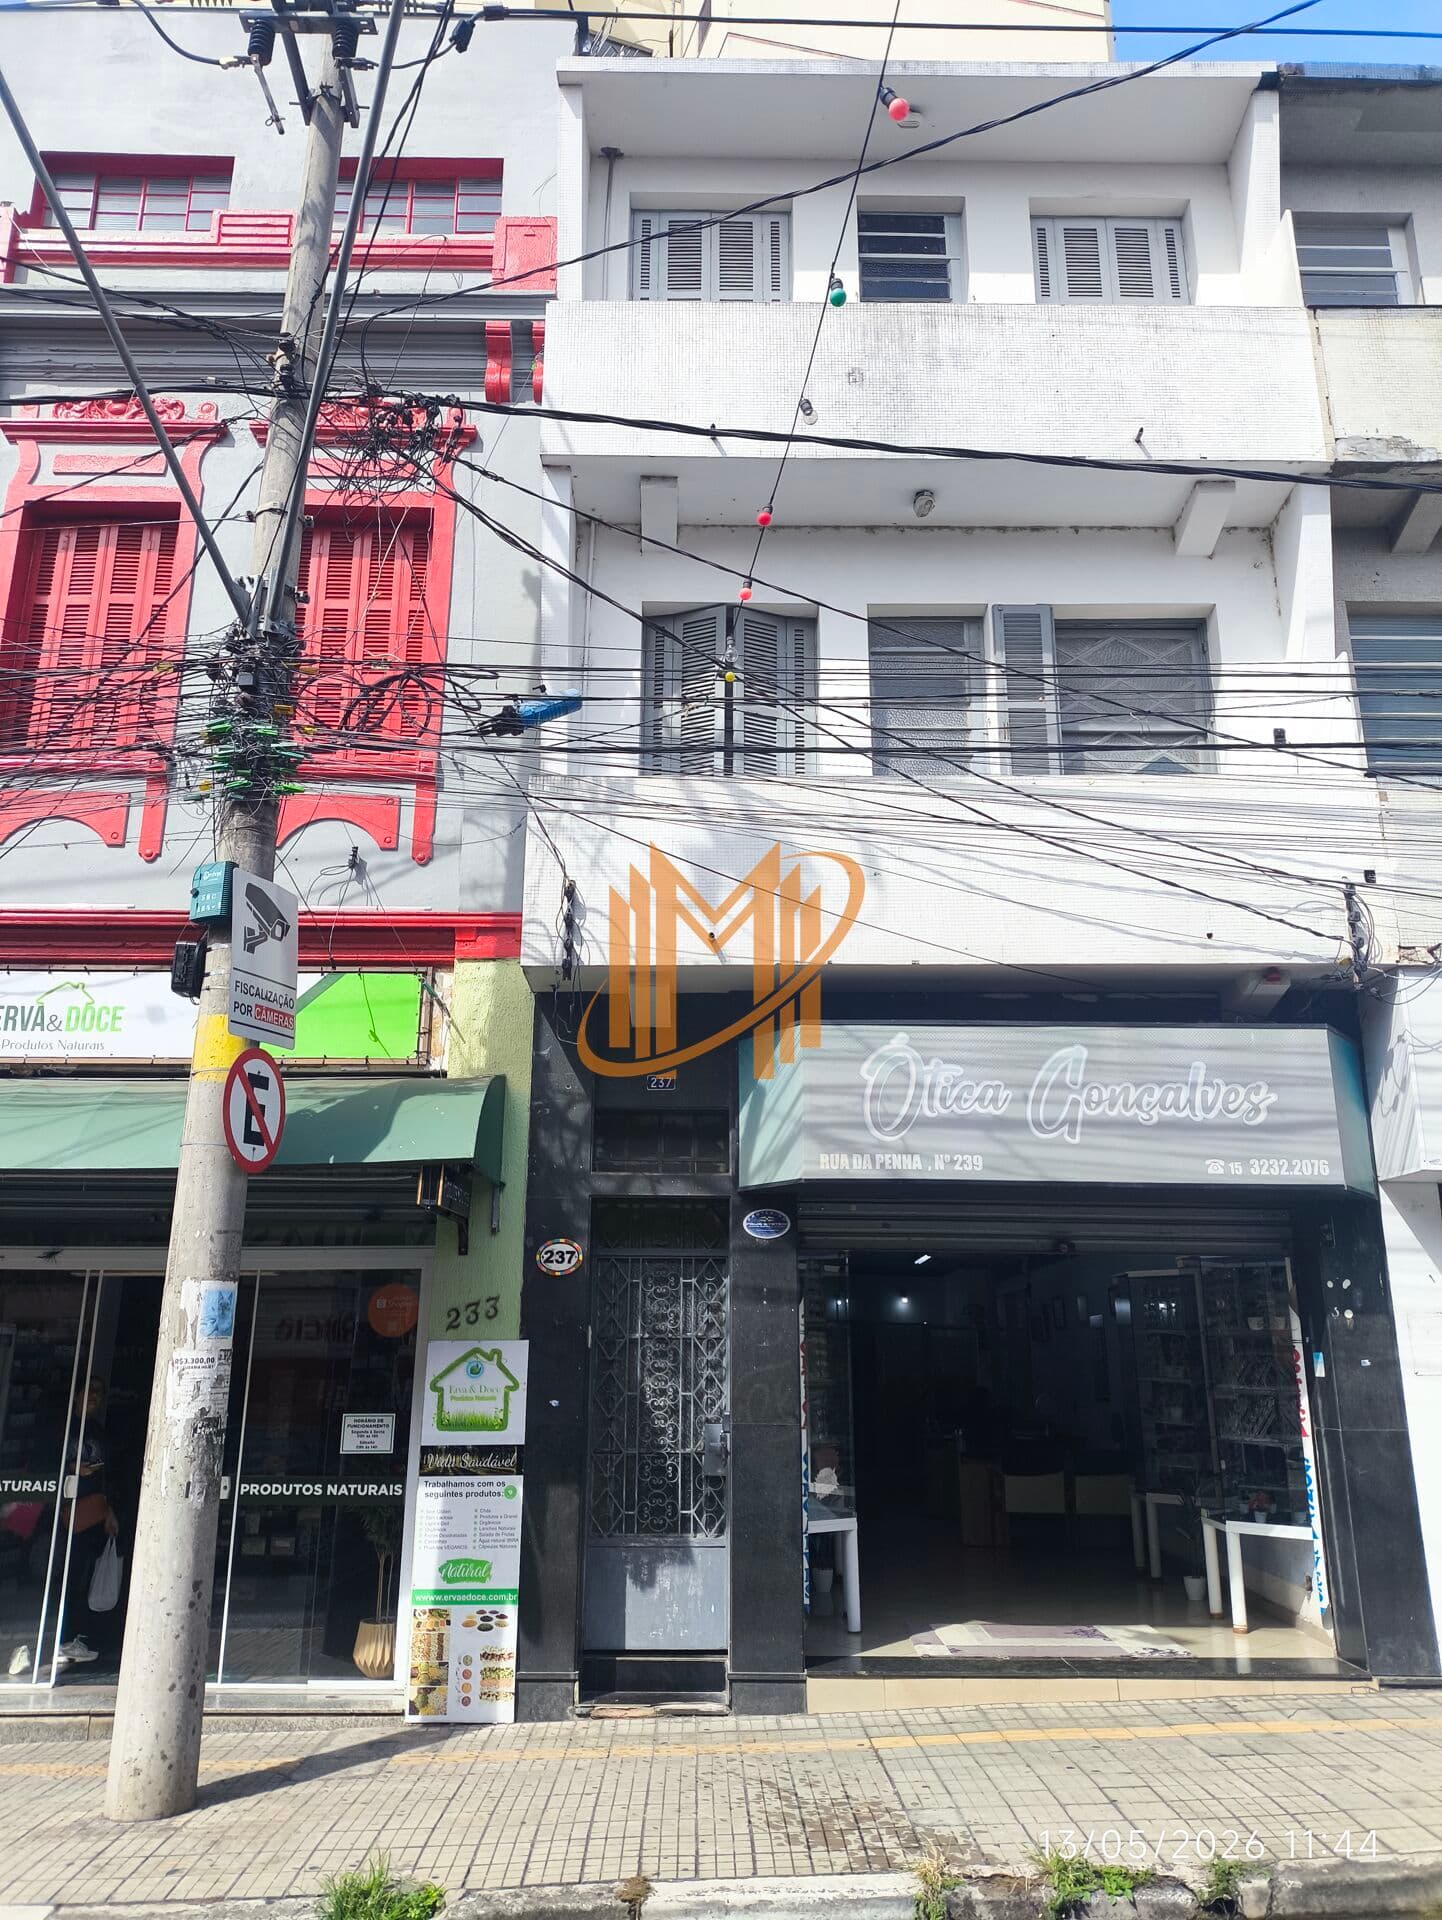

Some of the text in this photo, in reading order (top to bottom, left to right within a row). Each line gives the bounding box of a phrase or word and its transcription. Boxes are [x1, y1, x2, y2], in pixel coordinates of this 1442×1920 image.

[234, 980, 295, 1010] FISCALIZAÇÃO
[233, 1001, 294, 1030] POR CÂMERAS
[1, 1039, 105, 1050] Produtos Naturais
[650, 1076, 673, 1089] 237
[859, 1032, 1279, 1144] Ótica Gonçalves
[819, 1153, 849, 1170] RUA
[852, 1153, 873, 1170] DA
[953, 1154, 984, 1171] 239
[1228, 1158, 1330, 1176] 15 3232.2076
[543, 1250, 577, 1265] 237
[446, 1296, 500, 1332] 233
[459, 1450, 517, 1469] Saudável
[240, 1483, 403, 1496] PRODUTOS NATURAIS
[424, 1480, 475, 1488] Trabalhamos
[424, 1491, 463, 1499] seguintes
[441, 1562, 489, 1578] Natural
